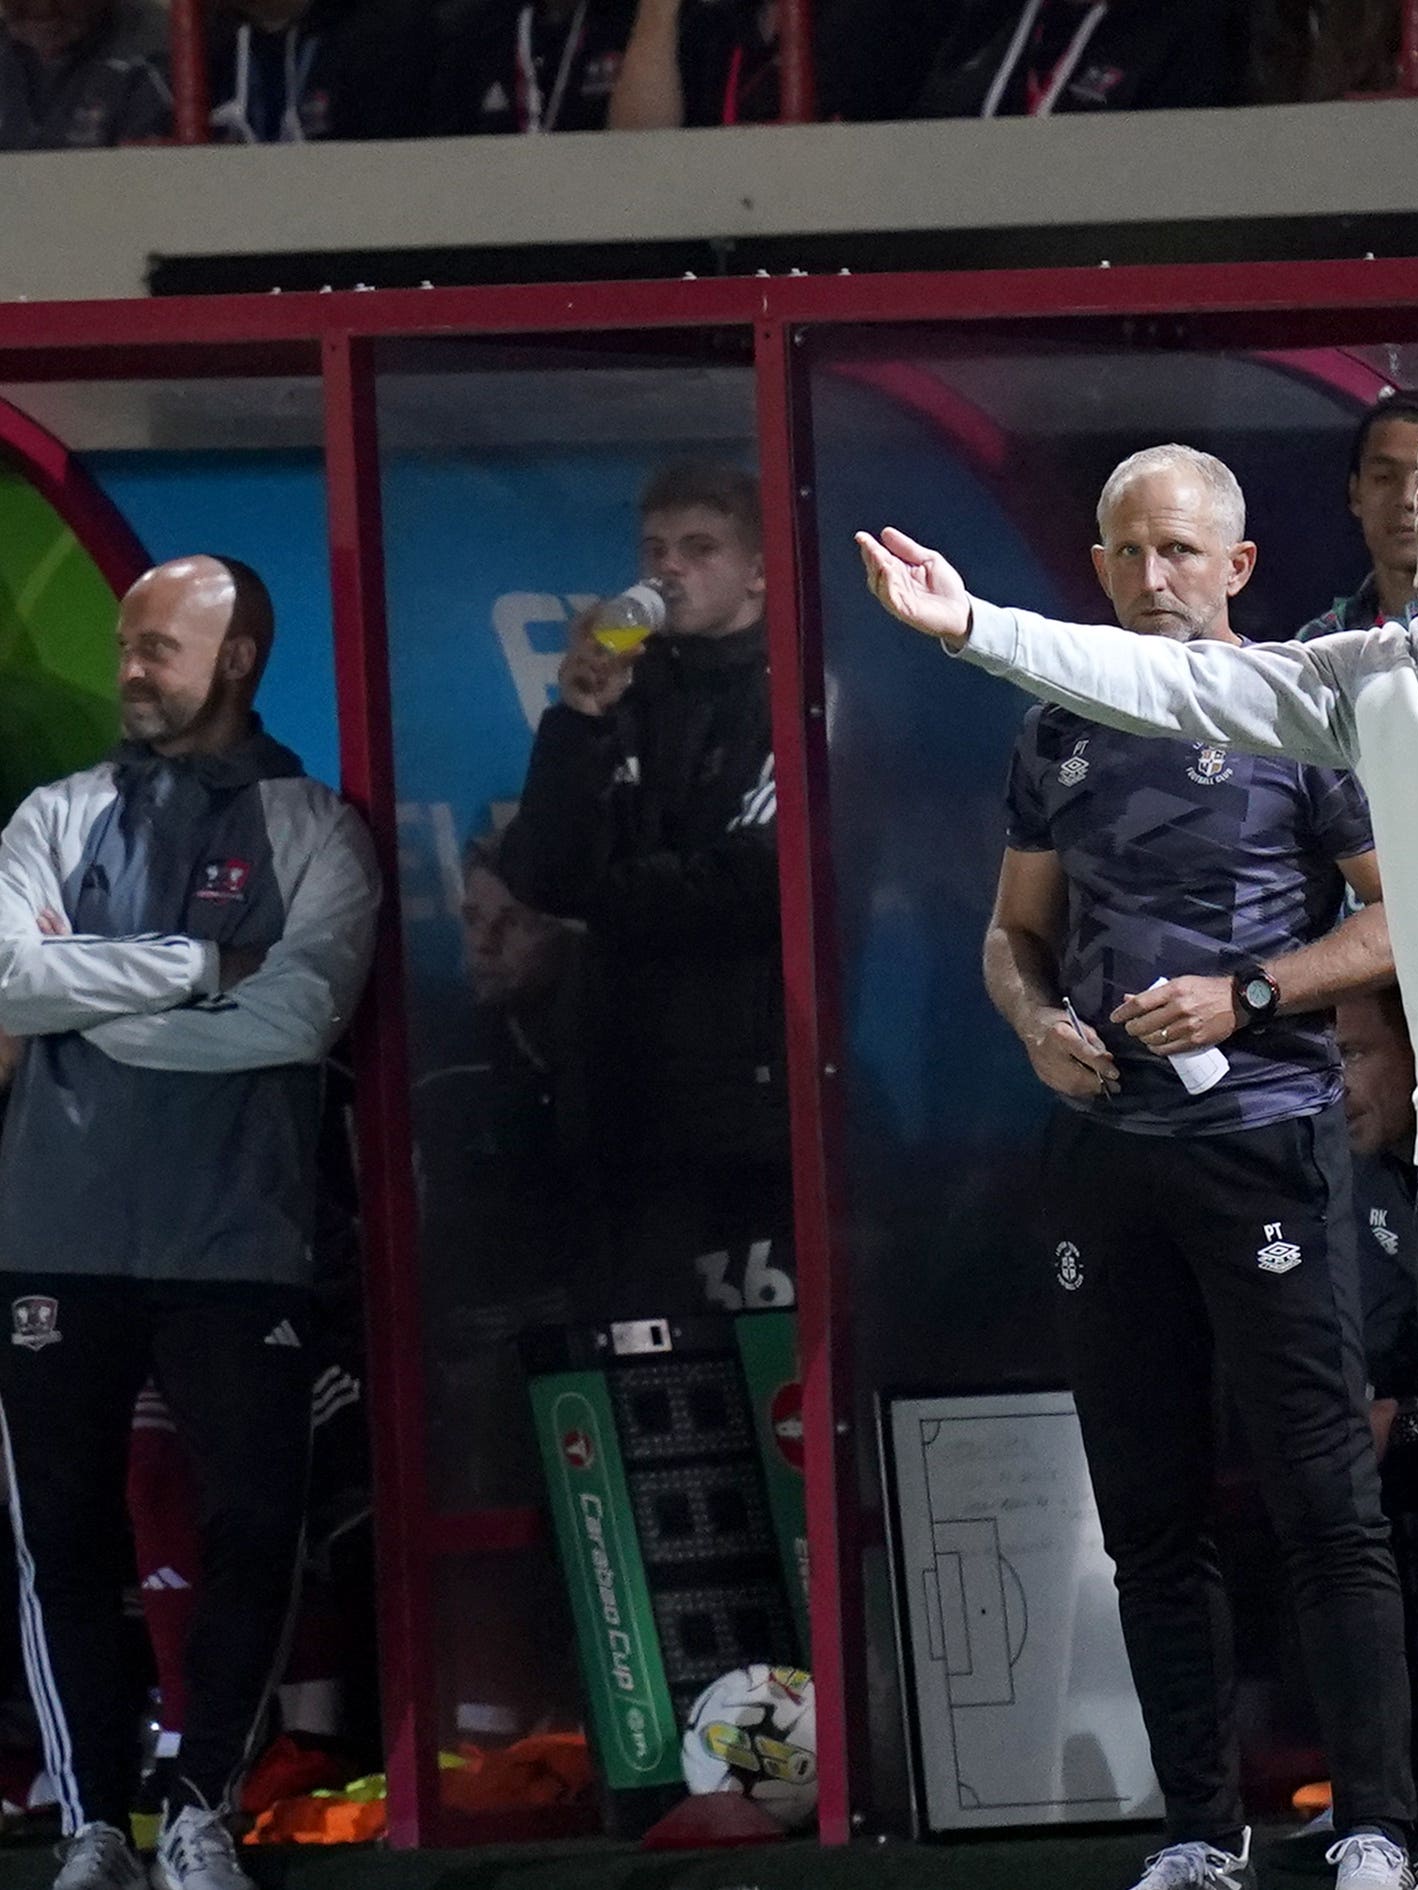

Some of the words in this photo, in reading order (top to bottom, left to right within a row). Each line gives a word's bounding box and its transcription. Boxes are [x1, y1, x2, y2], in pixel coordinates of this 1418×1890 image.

[1369, 1207, 1388, 1227] RK
[1263, 1221, 1283, 1243] PT
[579, 1493, 621, 1626] Carabao
[608, 1629, 634, 1692] Cup
